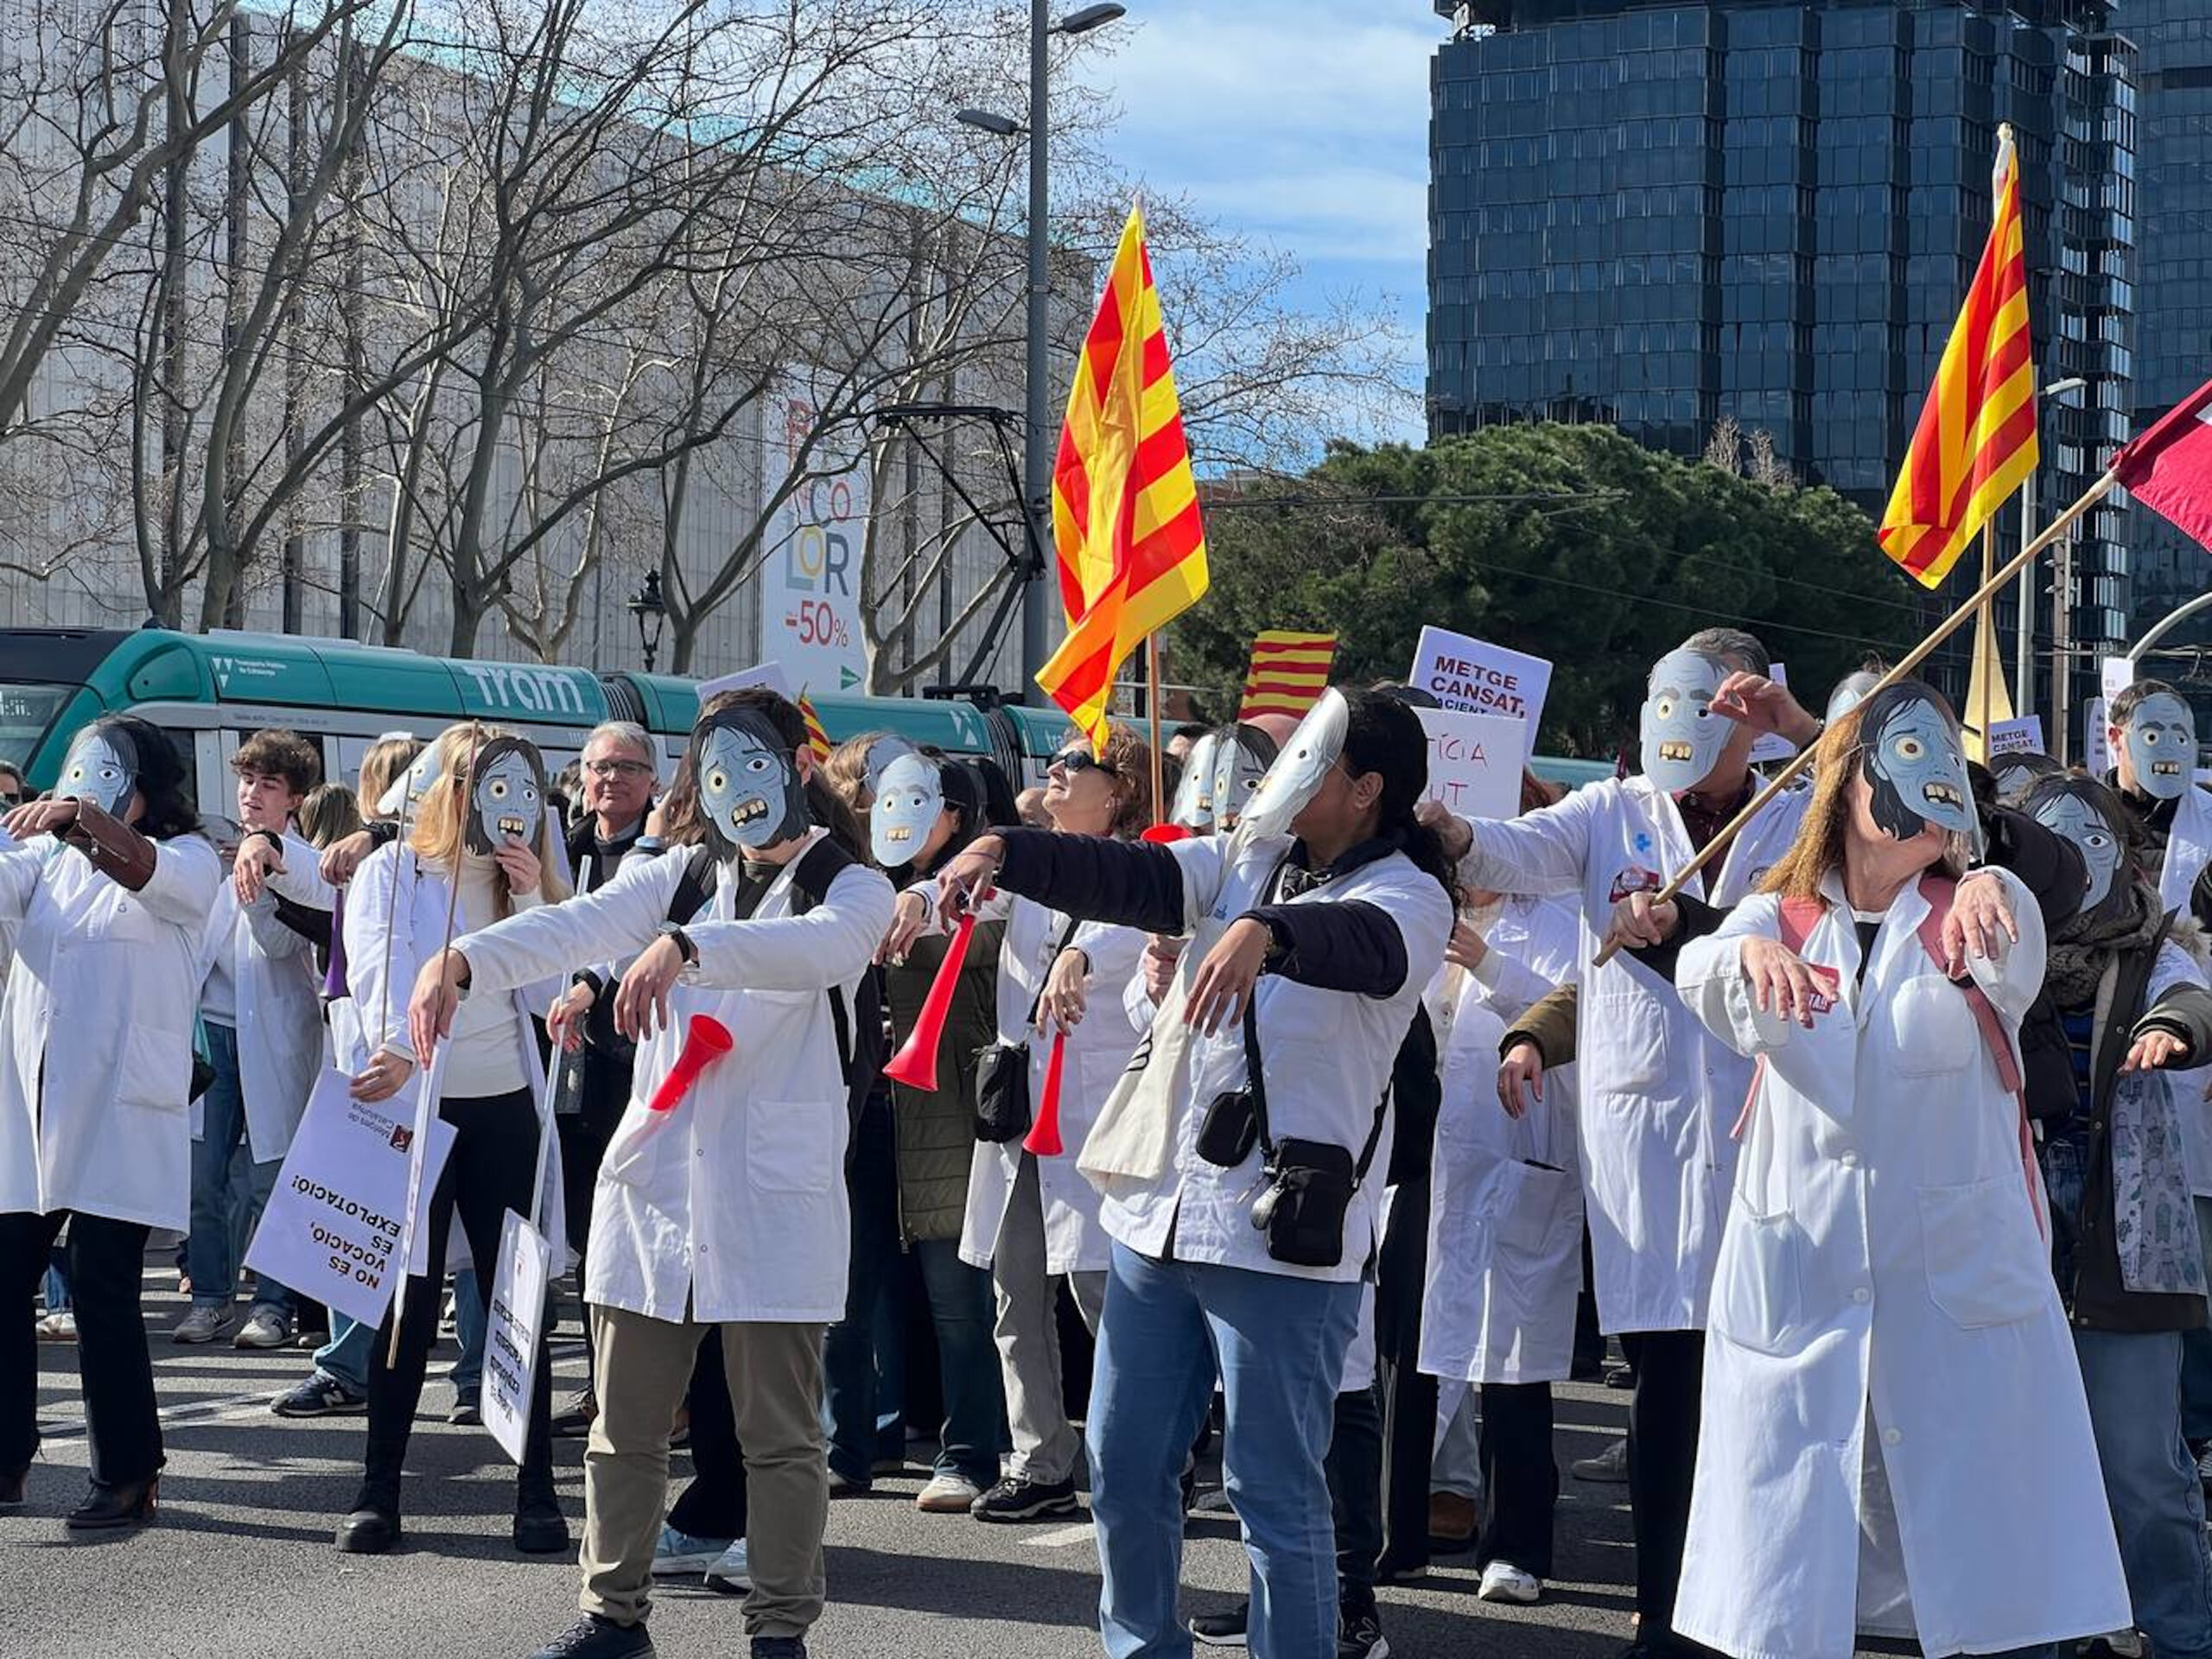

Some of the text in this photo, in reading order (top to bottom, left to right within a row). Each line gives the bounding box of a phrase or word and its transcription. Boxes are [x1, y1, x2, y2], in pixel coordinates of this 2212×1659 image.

[785, 601, 849, 648] -50%
[1434, 656, 1518, 690] METGE
[1431, 677, 1525, 719] CANSAT,
[1429, 783, 1468, 806] UT
[291, 1175, 402, 1237] EXPLOTACIÓ!
[310, 1221, 386, 1273] VOCACIÓ,
[371, 1235, 394, 1256] ÉS
[328, 1255, 380, 1290] NO ÉS
